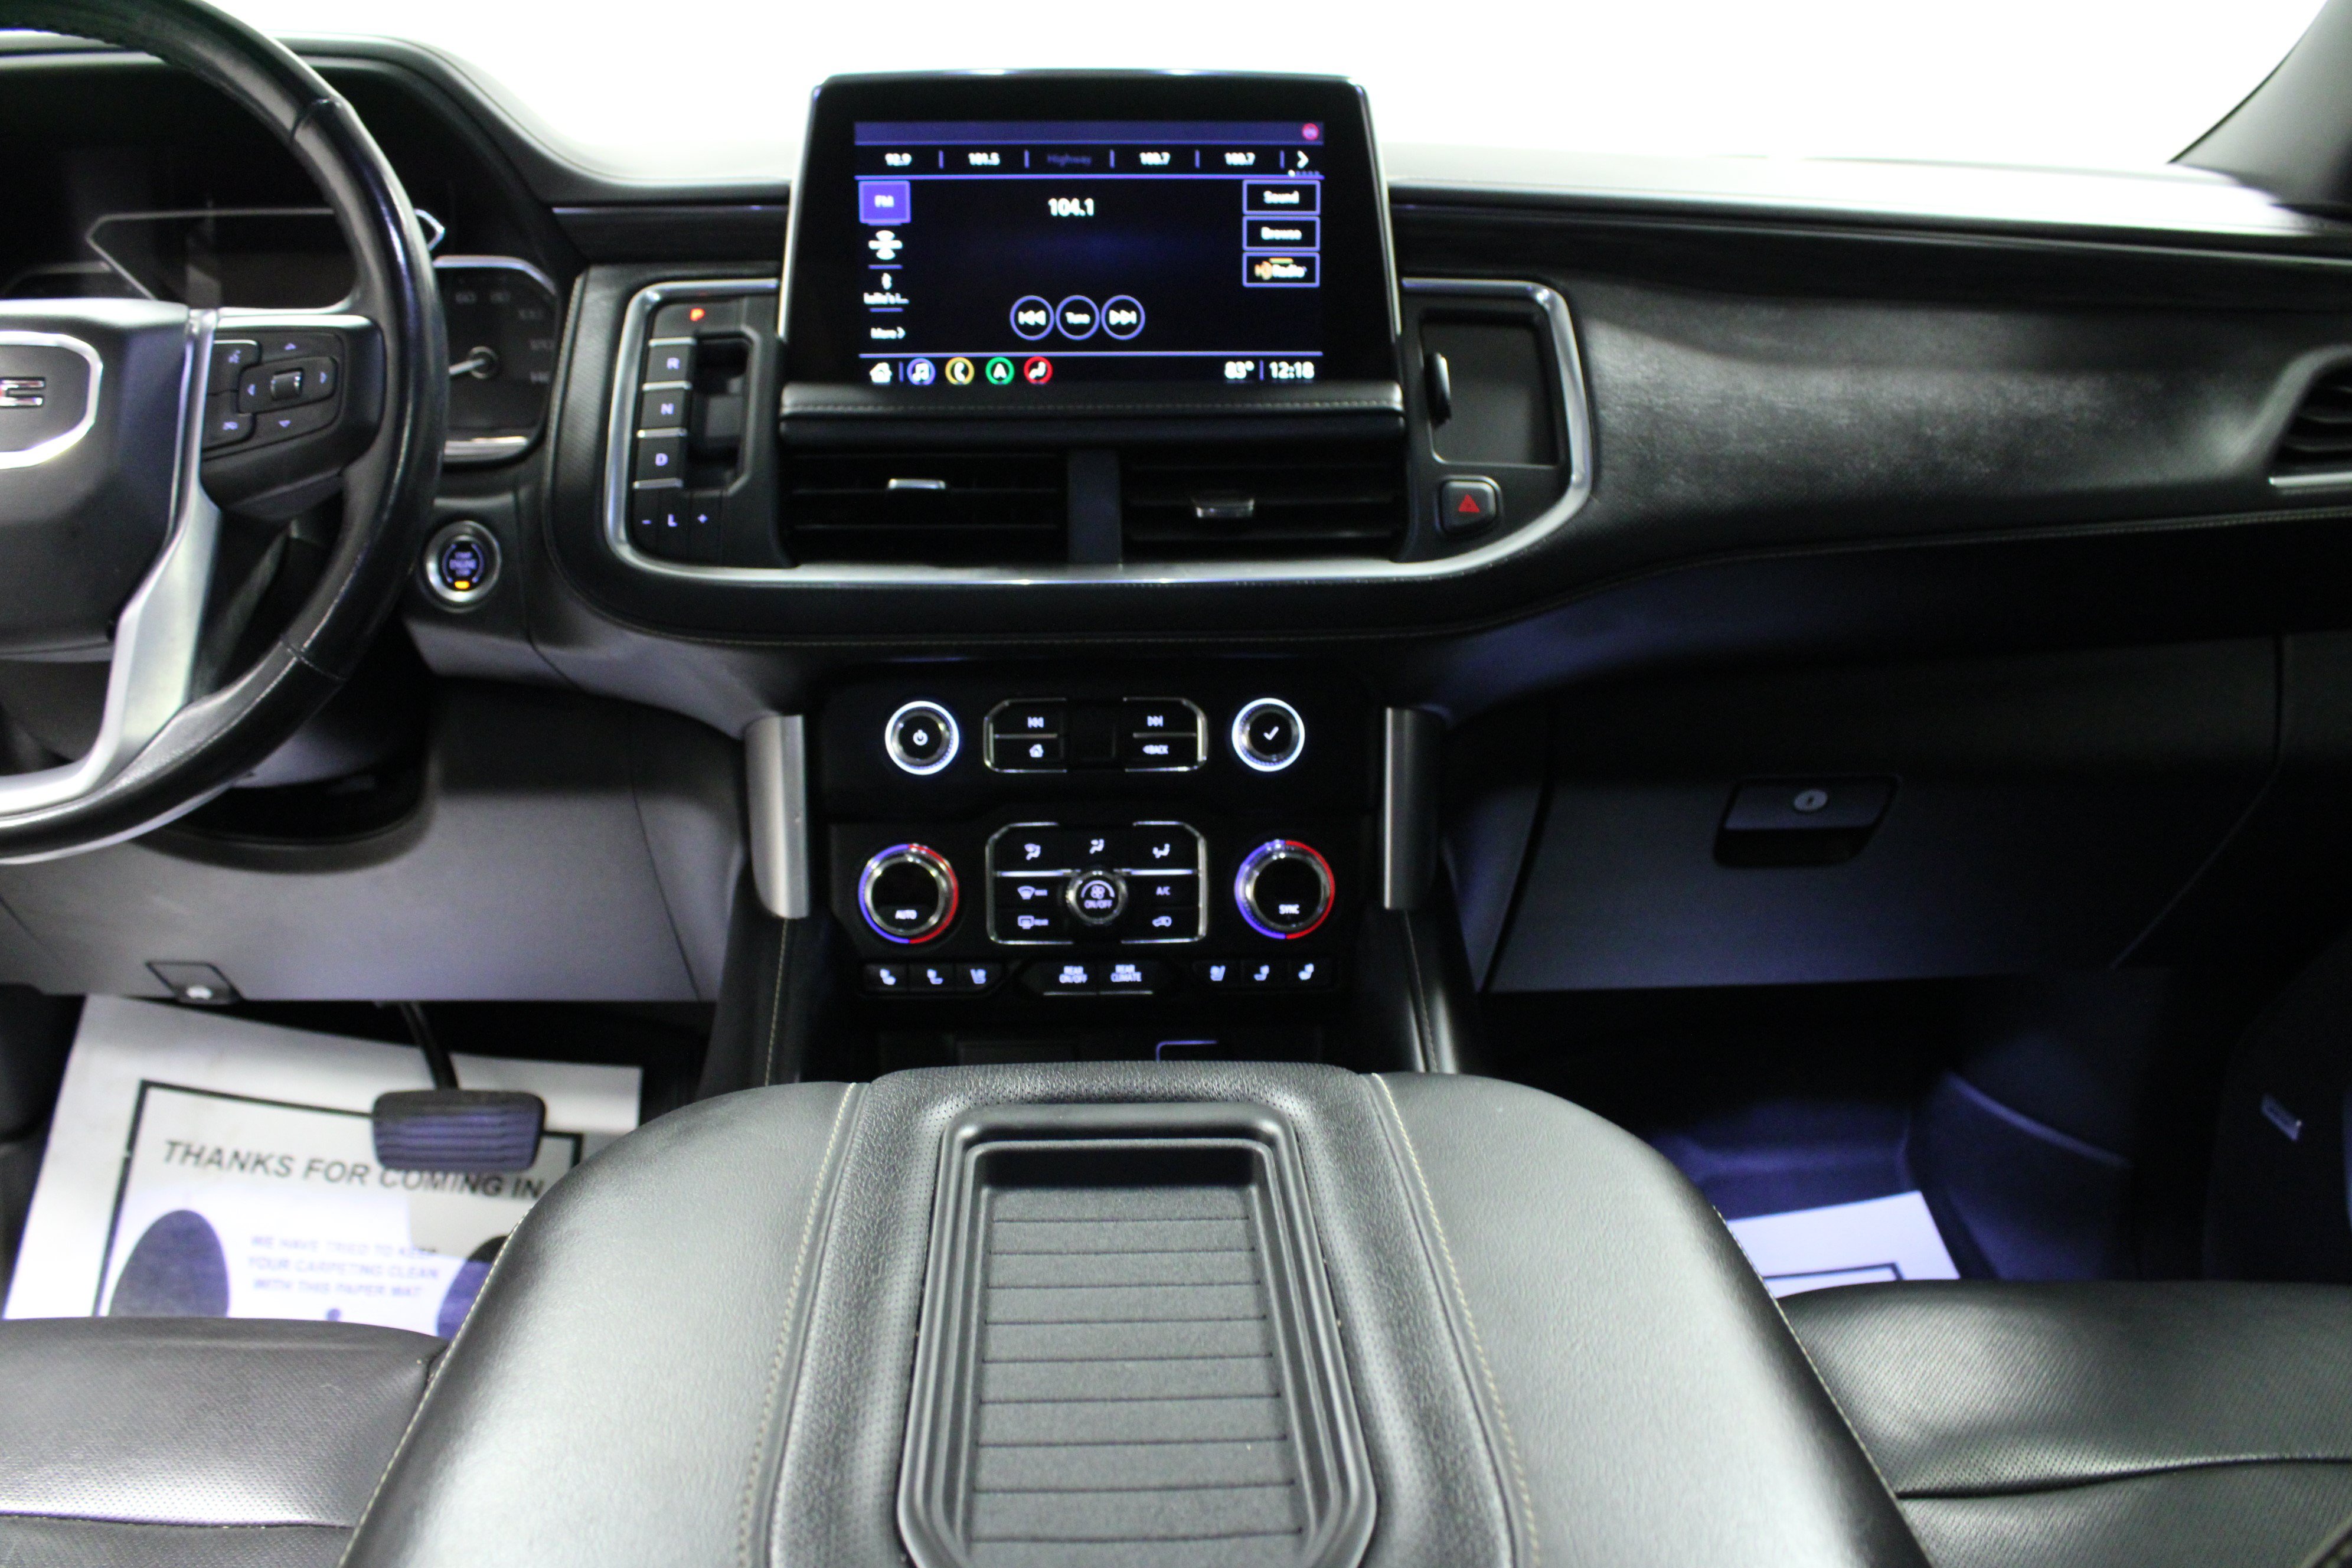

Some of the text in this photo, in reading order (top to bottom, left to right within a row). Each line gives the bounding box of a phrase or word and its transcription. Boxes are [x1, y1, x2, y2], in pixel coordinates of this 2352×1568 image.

[1048, 198, 1094, 217] 104.1
[690, 308, 705, 321] P
[666, 357, 680, 370] R
[1269, 361, 1315, 379] 12:18
[661, 403, 674, 415] N
[655, 453, 668, 466] D
[1149, 745, 1168, 754] BACK
[1156, 886, 1170, 896] A/C
[1084, 899, 1113, 909] ON/OFF
[1279, 904, 1299, 914] SYNC
[164, 1139, 545, 1199] THANKS FOR COMING IN
